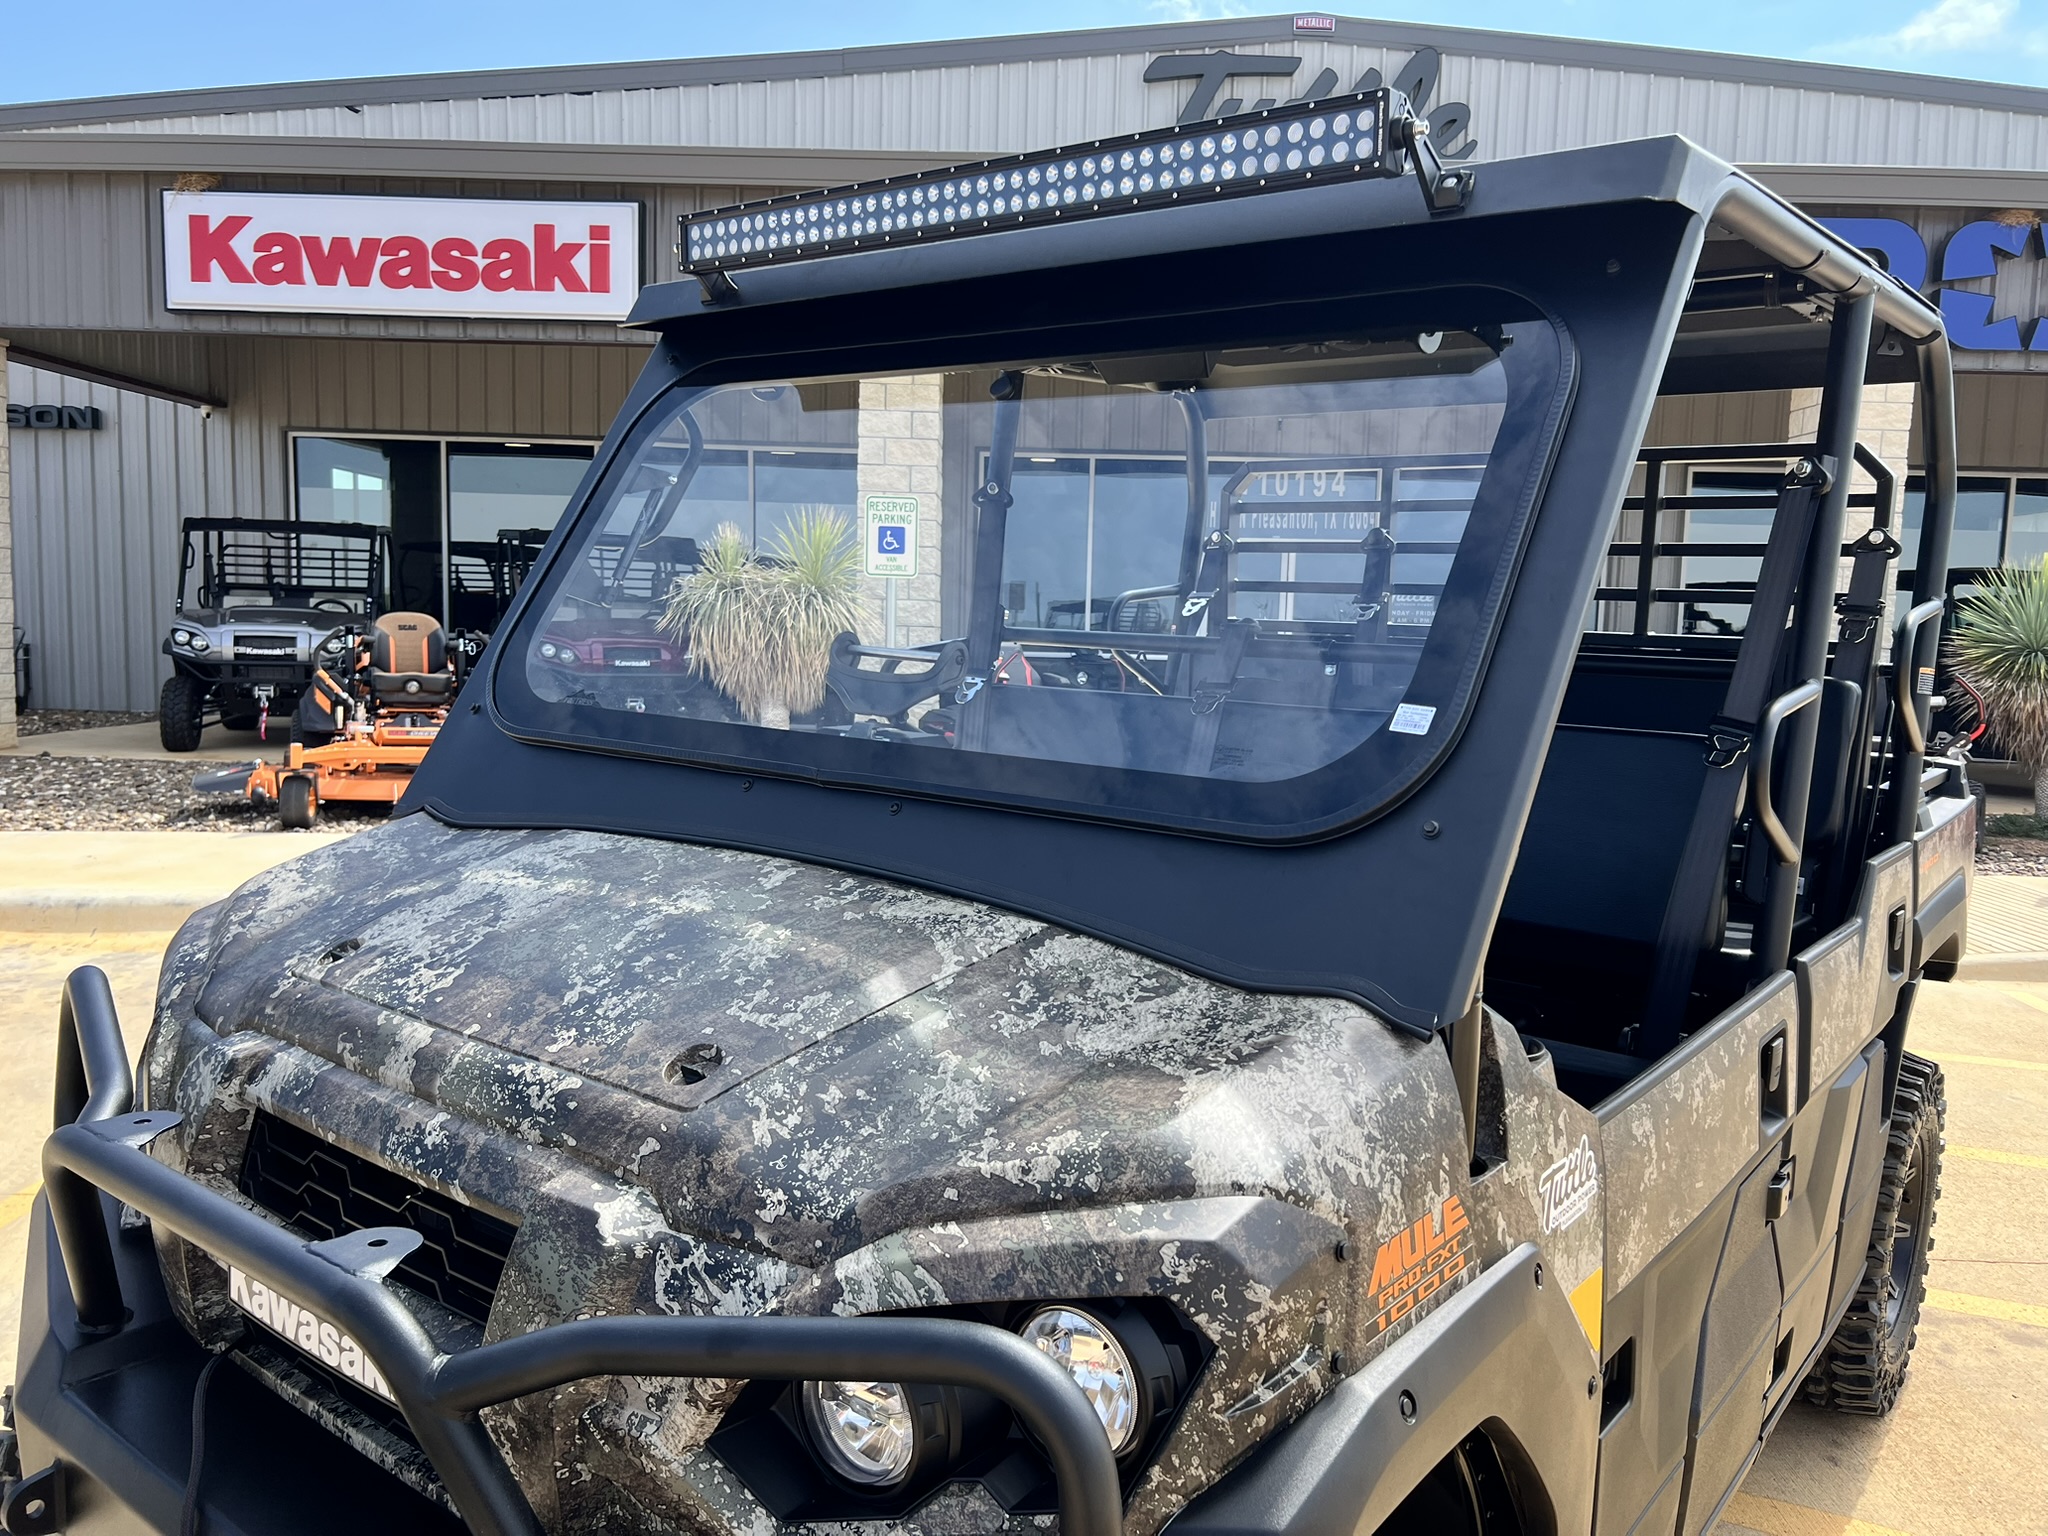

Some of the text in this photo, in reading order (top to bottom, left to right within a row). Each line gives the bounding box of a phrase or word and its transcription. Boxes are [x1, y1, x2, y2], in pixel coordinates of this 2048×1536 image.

[1297, 18, 1332, 28] METALLIC
[1143, 49, 1478, 160] Tle
[188, 214, 611, 293] Kawasaki
[1256, 472, 1346, 497] 10194
[869, 501, 915, 512] RESERVED
[872, 513, 912, 525] PARKING
[1251, 513, 1318, 535] Pleasanton,
[874, 564, 908, 572] ACCESSIBLE
[246, 647, 285, 656] Kawasaki
[615, 659, 651, 667] Kawasaki
[1540, 1135, 1597, 1233] Tuttle
[1367, 1194, 1470, 1298] MULE
[1378, 1235, 1461, 1309] PRO-FXT
[1377, 1254, 1465, 1332] 1000
[230, 1265, 396, 1401] Kawasa
[582, 1411, 611, 1453] STRATA
